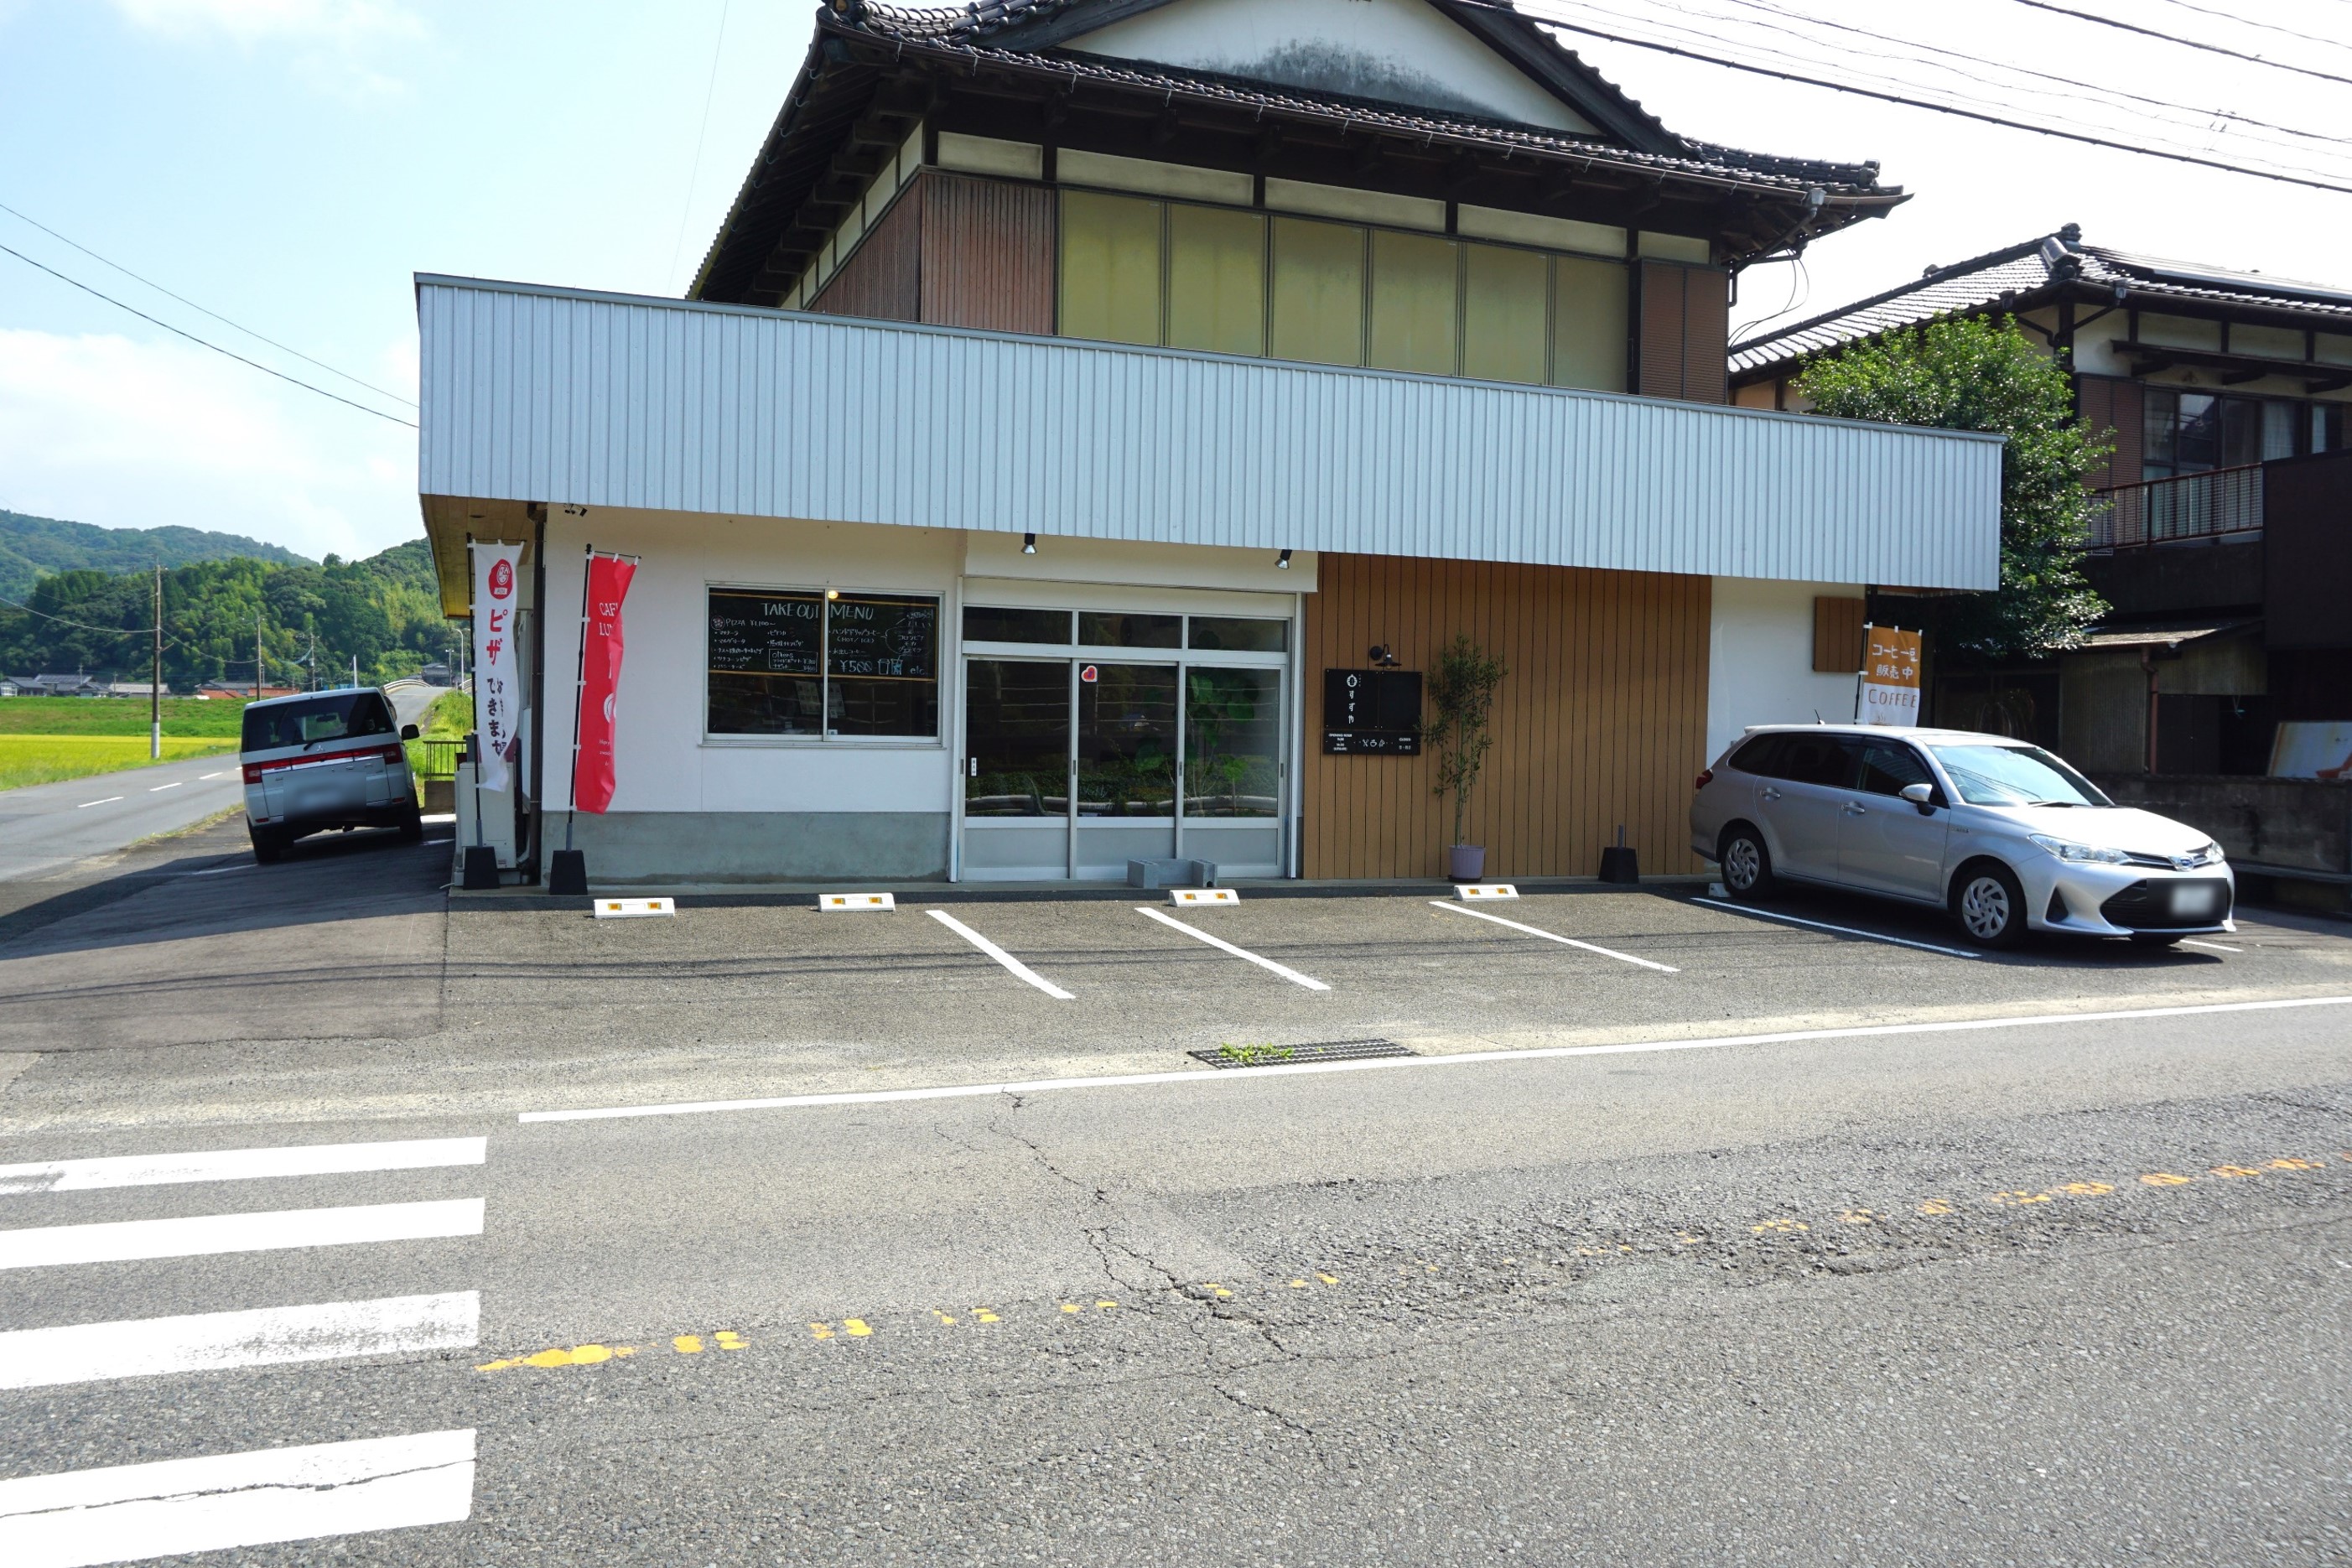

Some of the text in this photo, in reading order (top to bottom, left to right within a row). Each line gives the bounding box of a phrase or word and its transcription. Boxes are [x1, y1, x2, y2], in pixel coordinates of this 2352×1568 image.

[761, 603, 874, 620] TAKE OUT MENU
[486, 609, 508, 666] ピザ
[1872, 643, 1918, 662] コーヒー豆
[1876, 664, 1913, 680] 販売中
[1868, 688, 1918, 709] COFFEE
